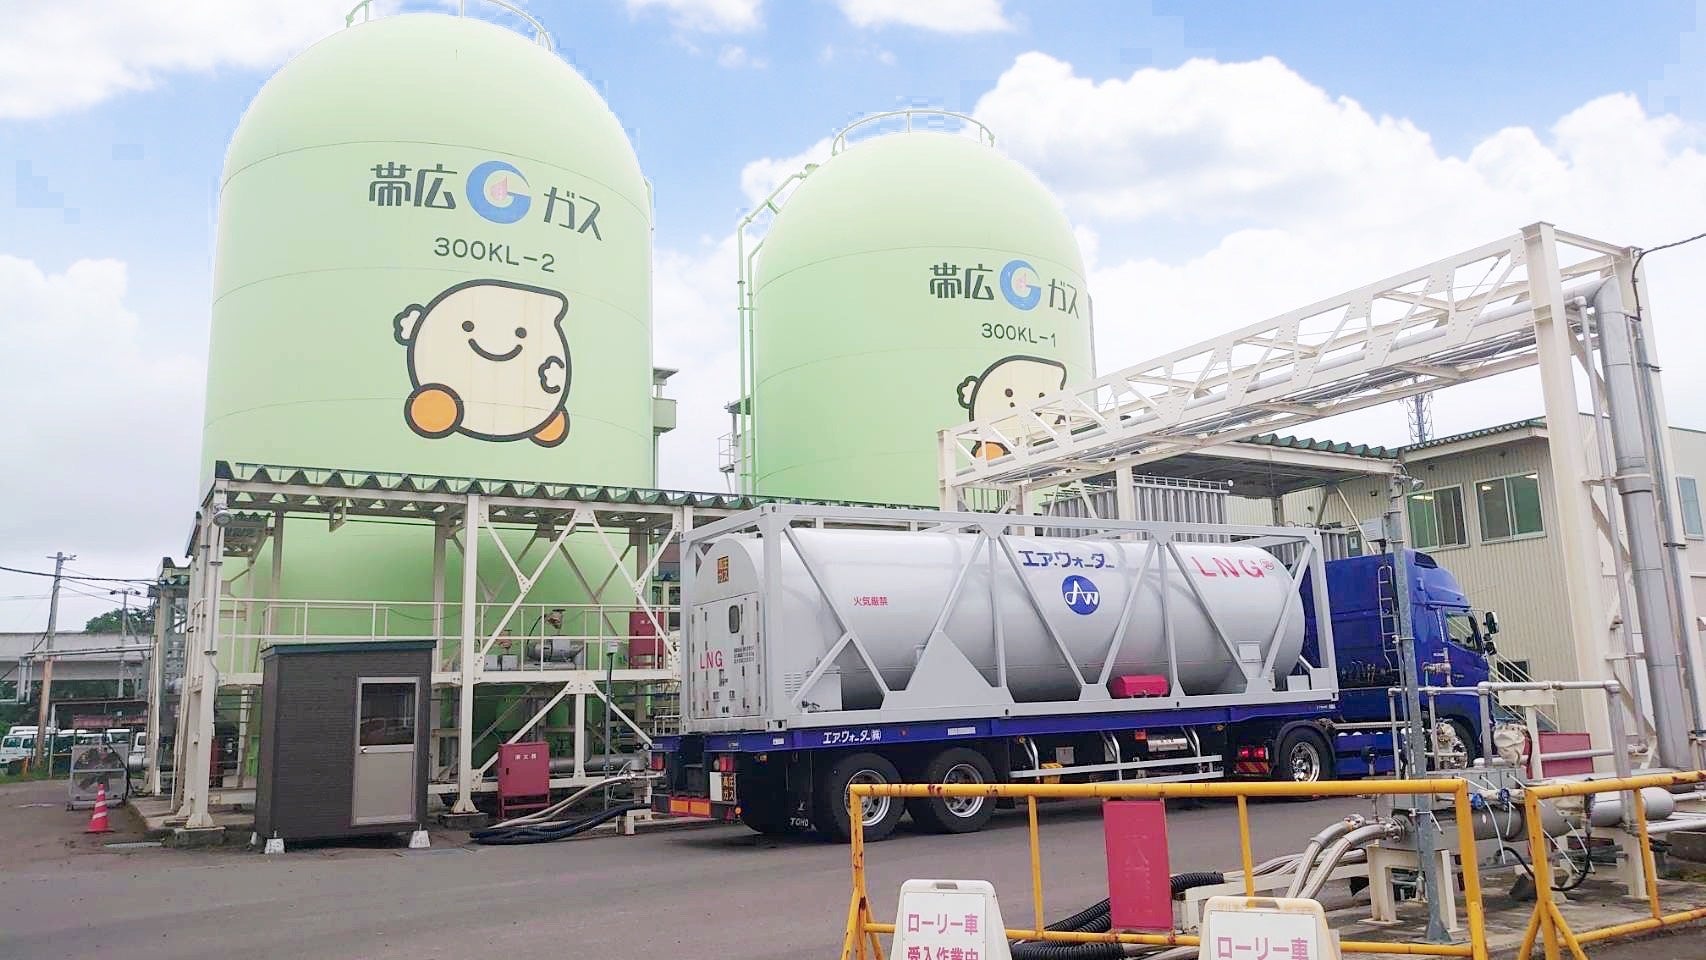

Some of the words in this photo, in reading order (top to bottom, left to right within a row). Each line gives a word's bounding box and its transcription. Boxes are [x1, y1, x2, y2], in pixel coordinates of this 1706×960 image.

[369, 161, 458, 209] 帯広
[543, 186, 602, 241] ガス
[434, 236, 555, 273] 300KL-2
[929, 262, 995, 301] 帯広
[1047, 278, 1079, 320] ガス
[981, 322, 1056, 348] 300KL-1
[1191, 556, 1265, 578] LNG
[853, 595, 889, 607] 火気厳禁
[700, 650, 723, 670] LNG
[908, 913, 979, 936] ローリー車
[1217, 936, 1310, 960] ローリー車
